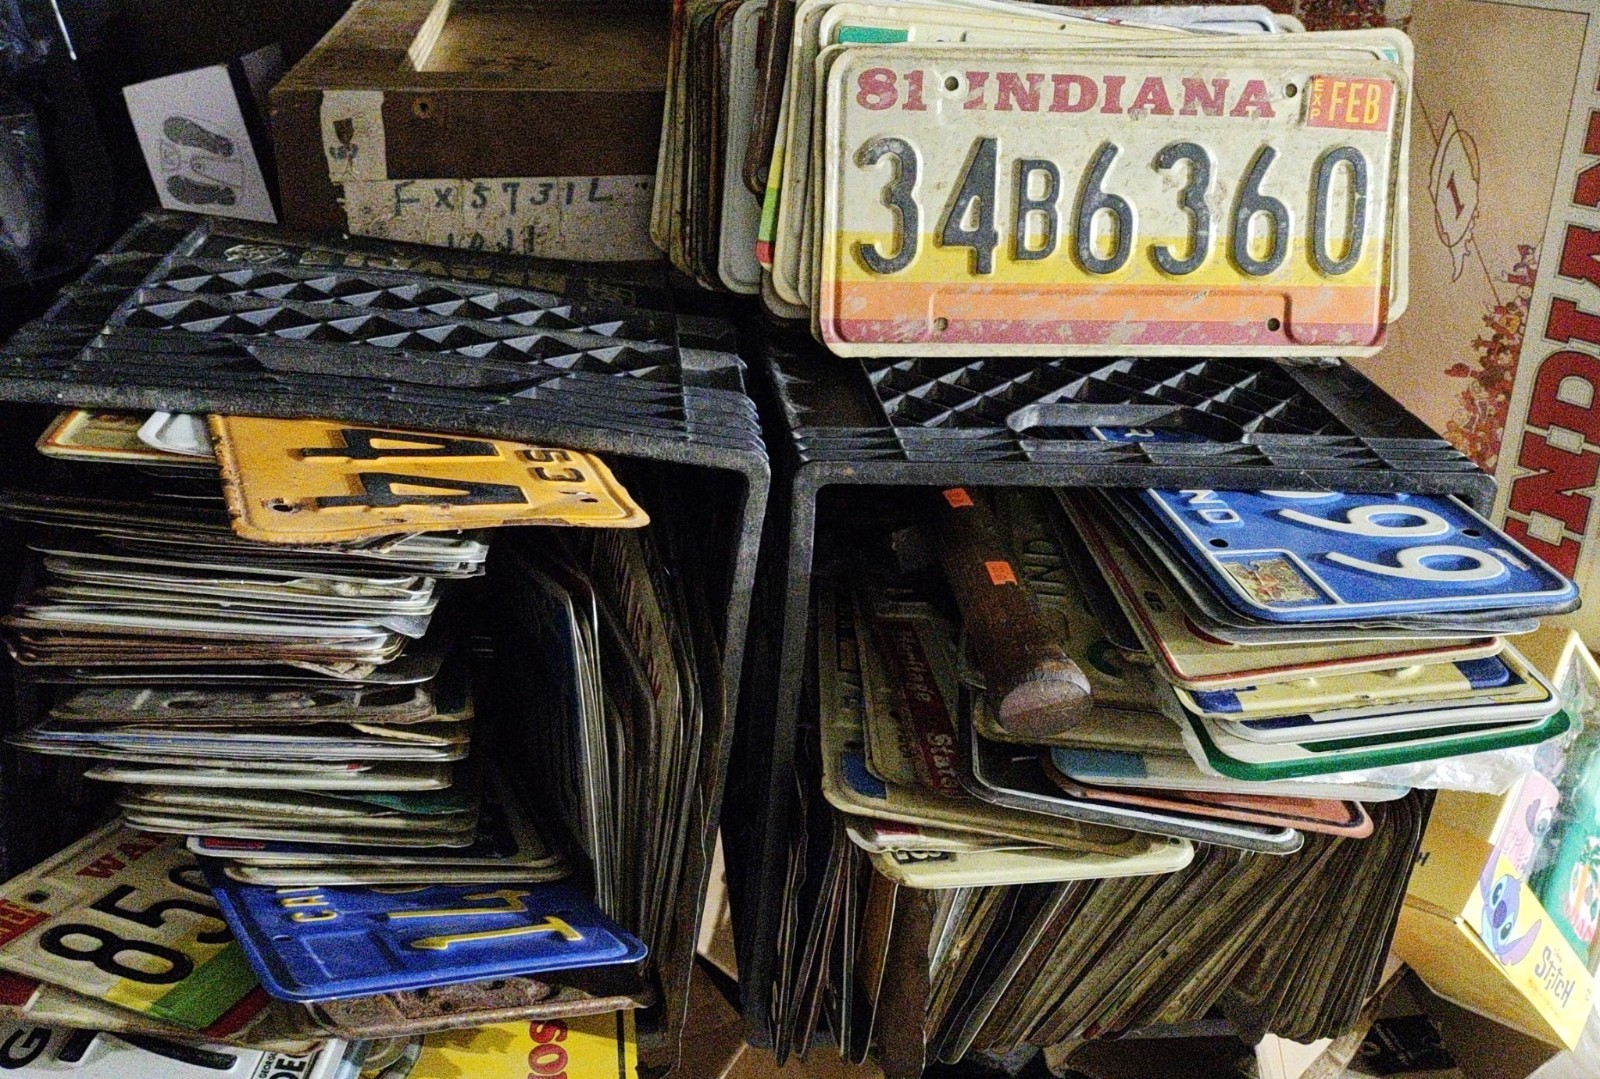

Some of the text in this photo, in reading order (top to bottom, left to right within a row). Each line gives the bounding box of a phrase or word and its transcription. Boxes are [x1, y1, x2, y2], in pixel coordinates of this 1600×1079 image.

[855, 67, 1277, 119] 81 INDIANA
[1327, 80, 1382, 127] FEB
[852, 136, 1372, 277] 34B6360
[1258, 489, 1505, 582] 99
